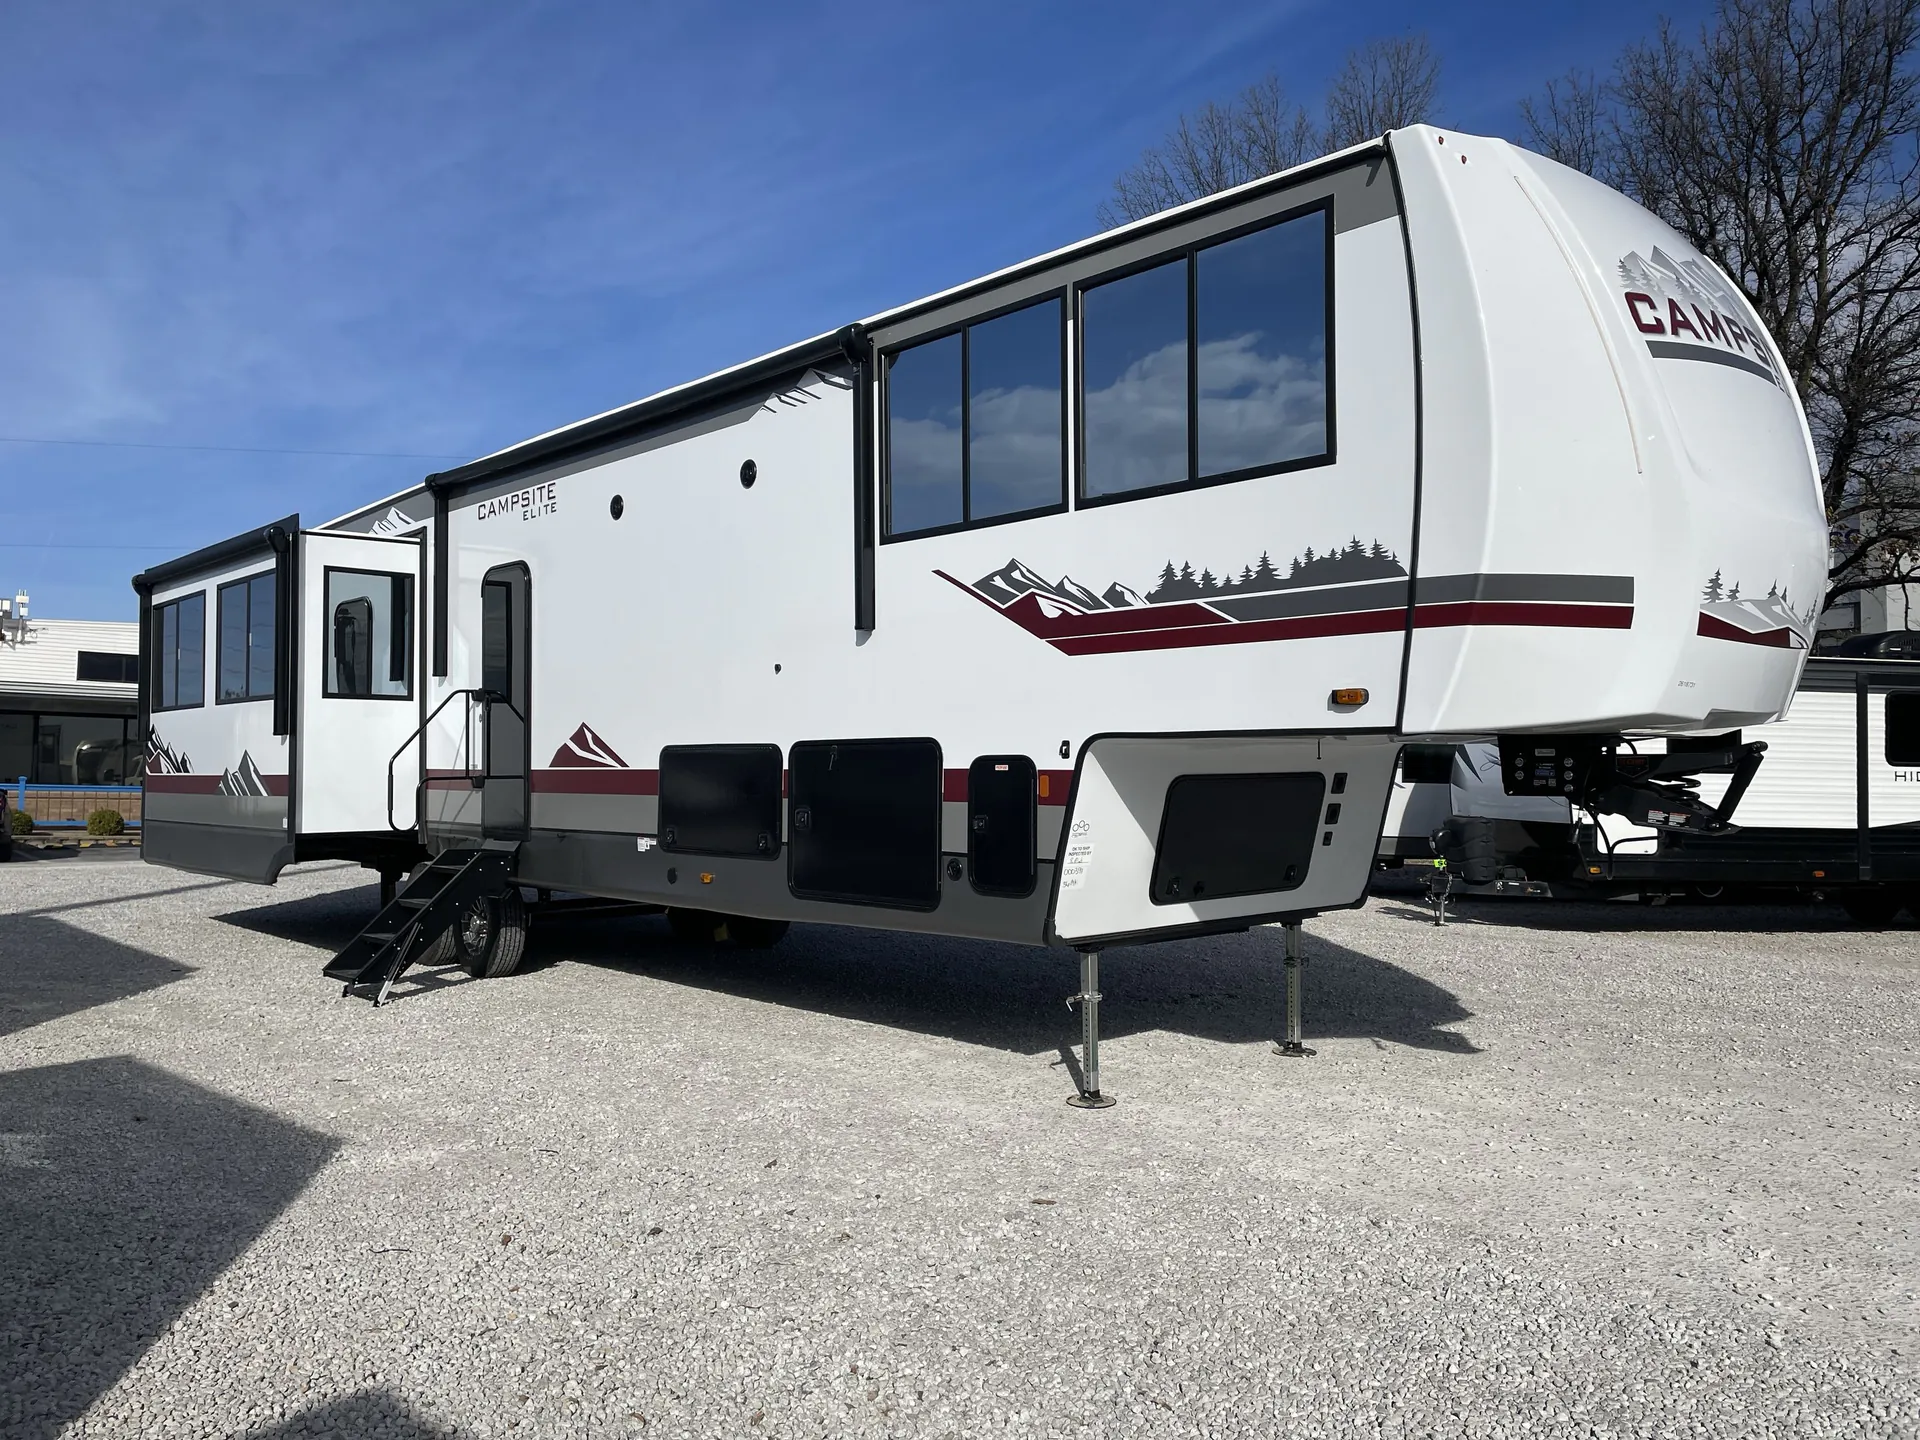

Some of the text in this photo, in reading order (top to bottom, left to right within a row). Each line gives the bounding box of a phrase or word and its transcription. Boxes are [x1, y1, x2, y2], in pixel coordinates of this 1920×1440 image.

[1624, 291, 1776, 372] CAMPS
[478, 482, 556, 521] CAMPSITE
[522, 502, 557, 521] ELITE
